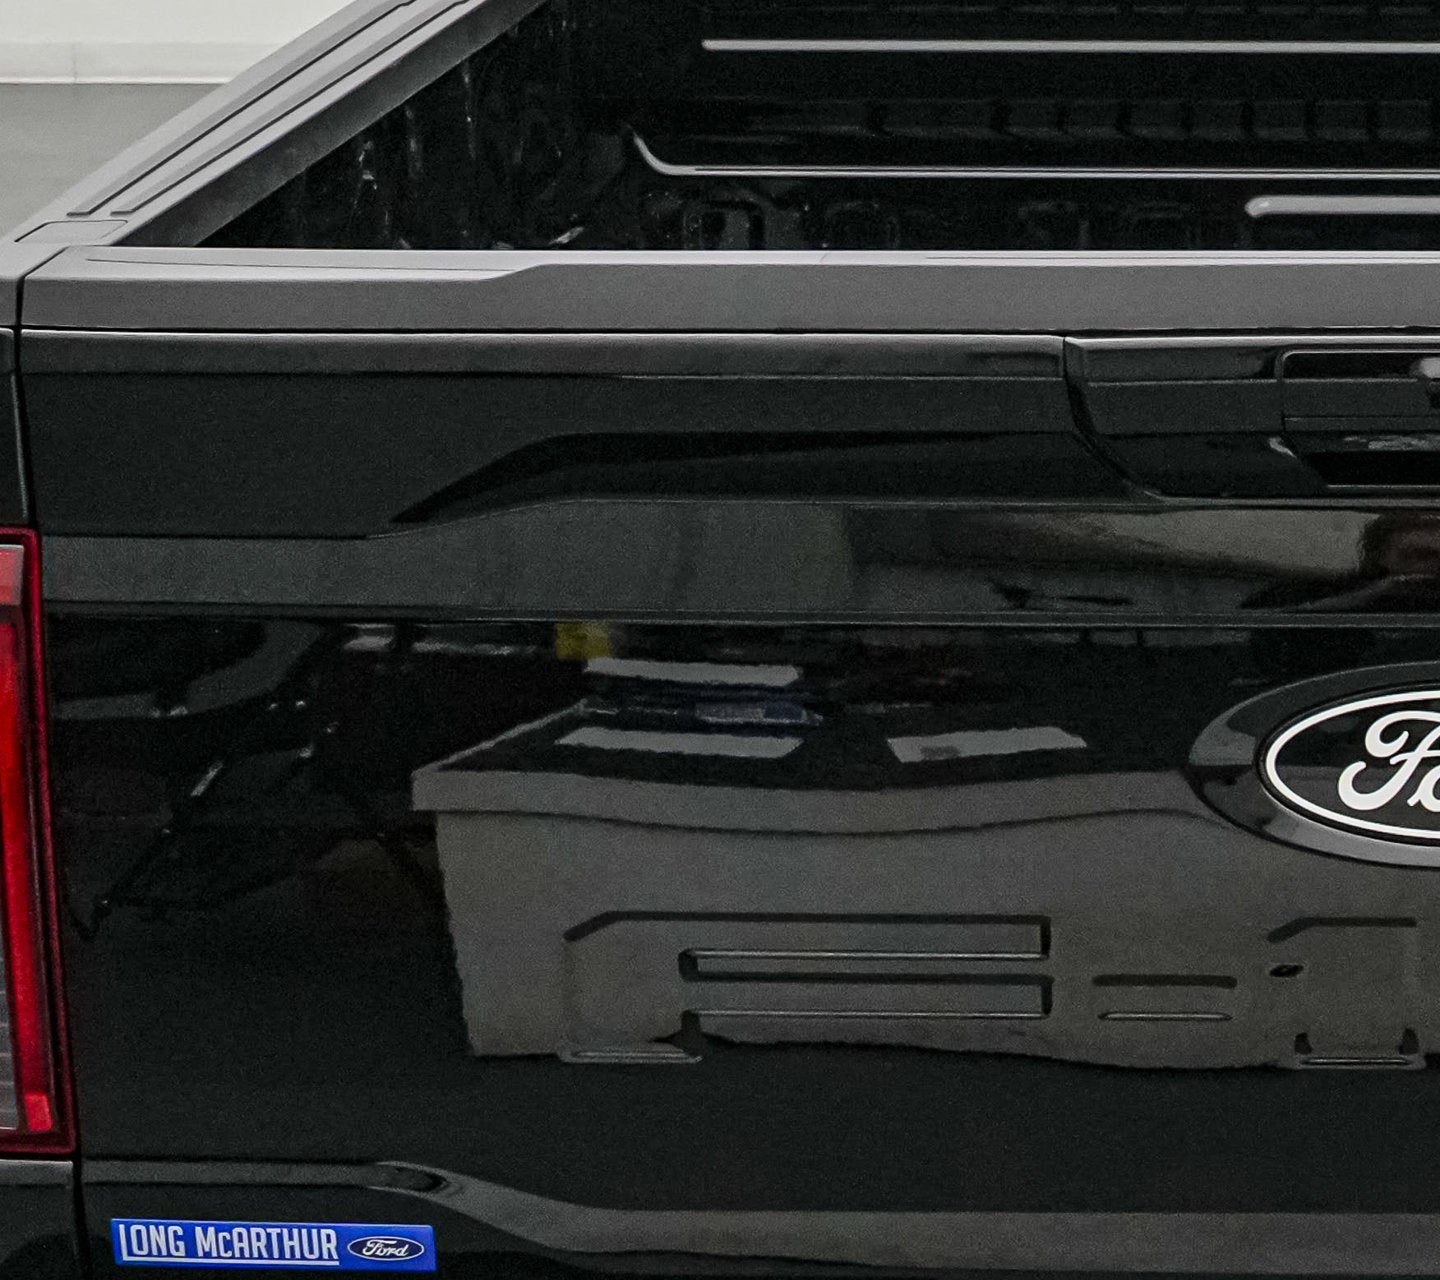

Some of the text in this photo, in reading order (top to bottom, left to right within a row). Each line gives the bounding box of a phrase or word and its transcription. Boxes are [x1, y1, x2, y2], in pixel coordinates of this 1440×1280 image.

[118, 1223, 411, 1260] LONG McARTHUR Ford
